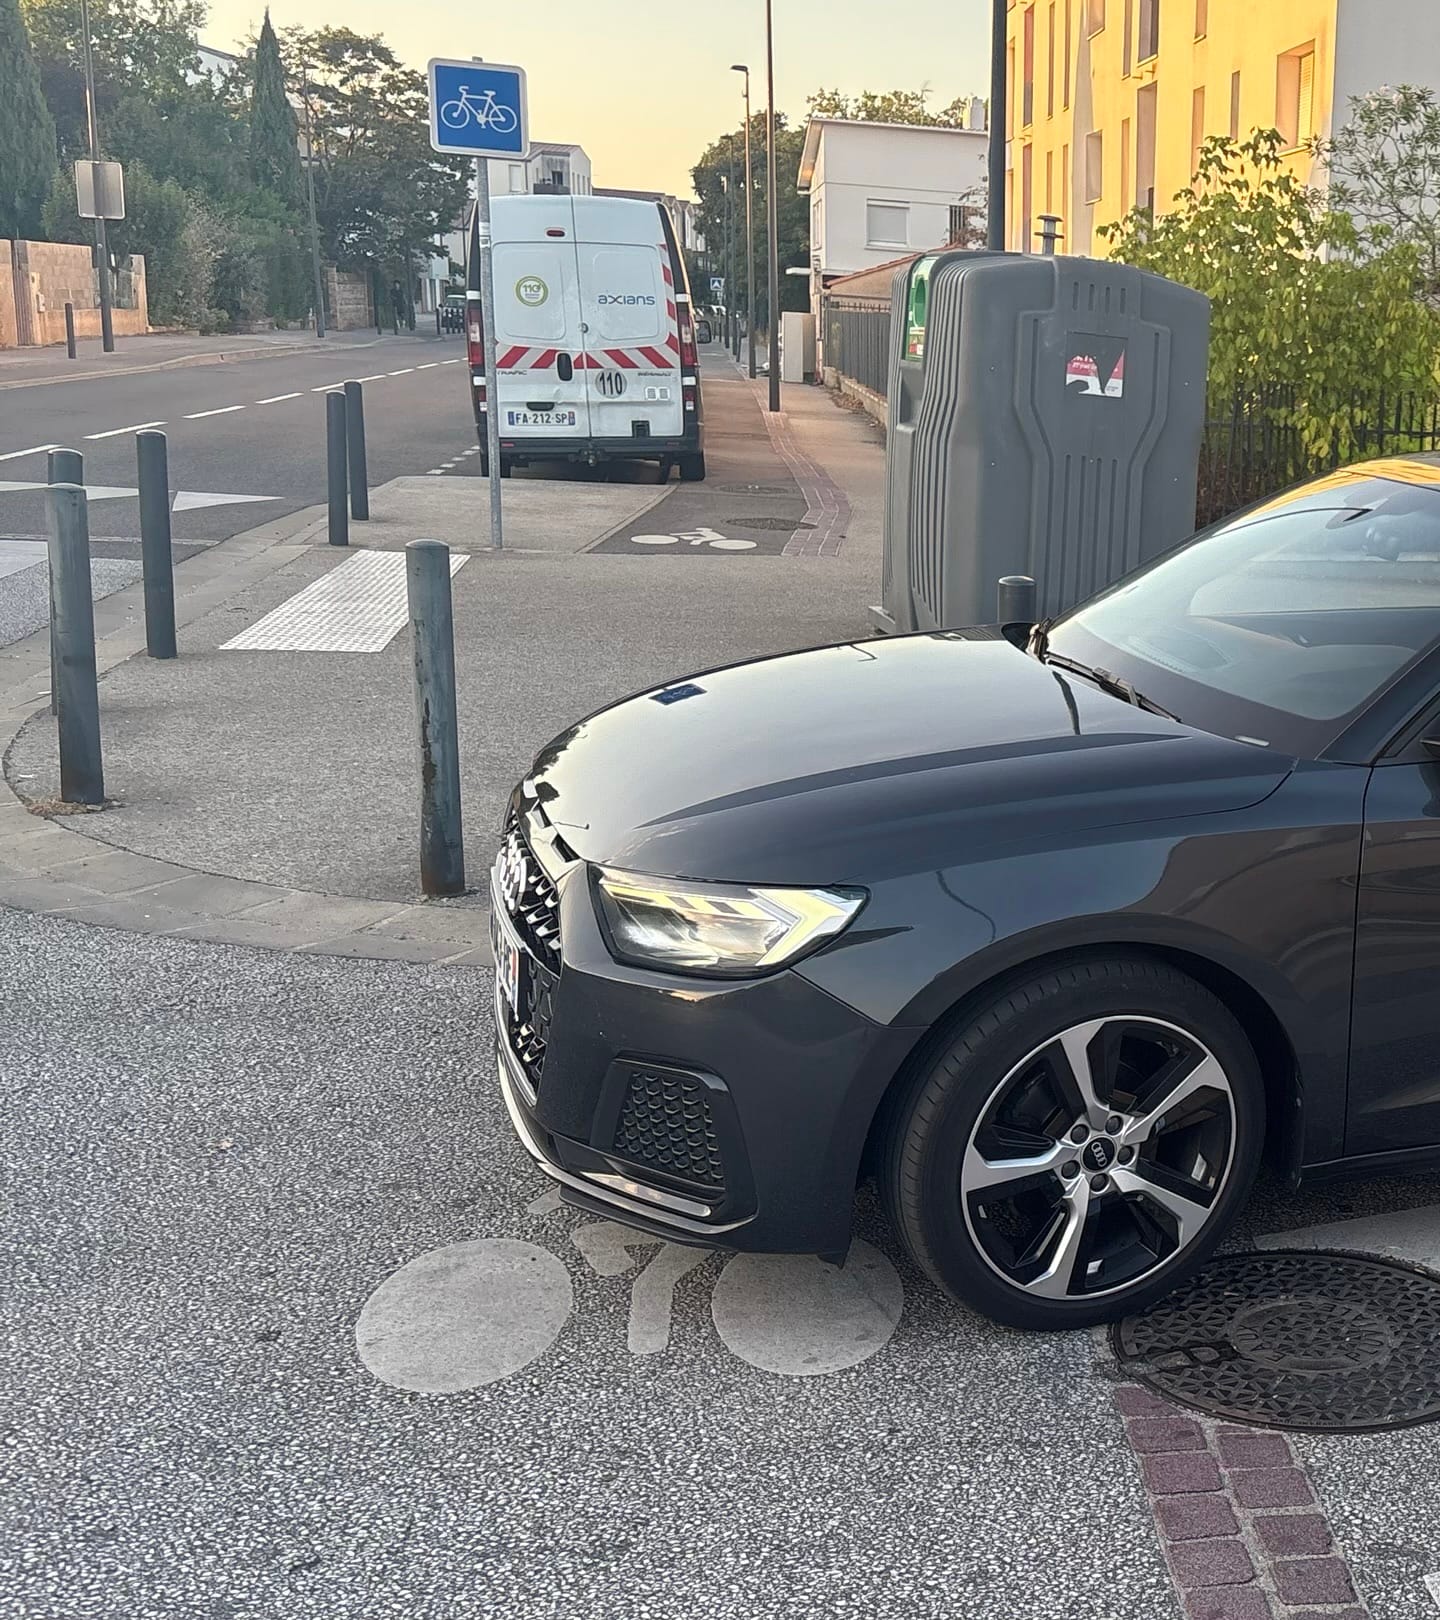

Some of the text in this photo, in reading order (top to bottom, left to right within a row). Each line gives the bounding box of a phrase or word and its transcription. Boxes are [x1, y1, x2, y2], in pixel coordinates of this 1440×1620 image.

[598, 295, 656, 306] axians
[599, 372, 623, 395] 110
[515, 411, 567, 424] FA-212-SP
